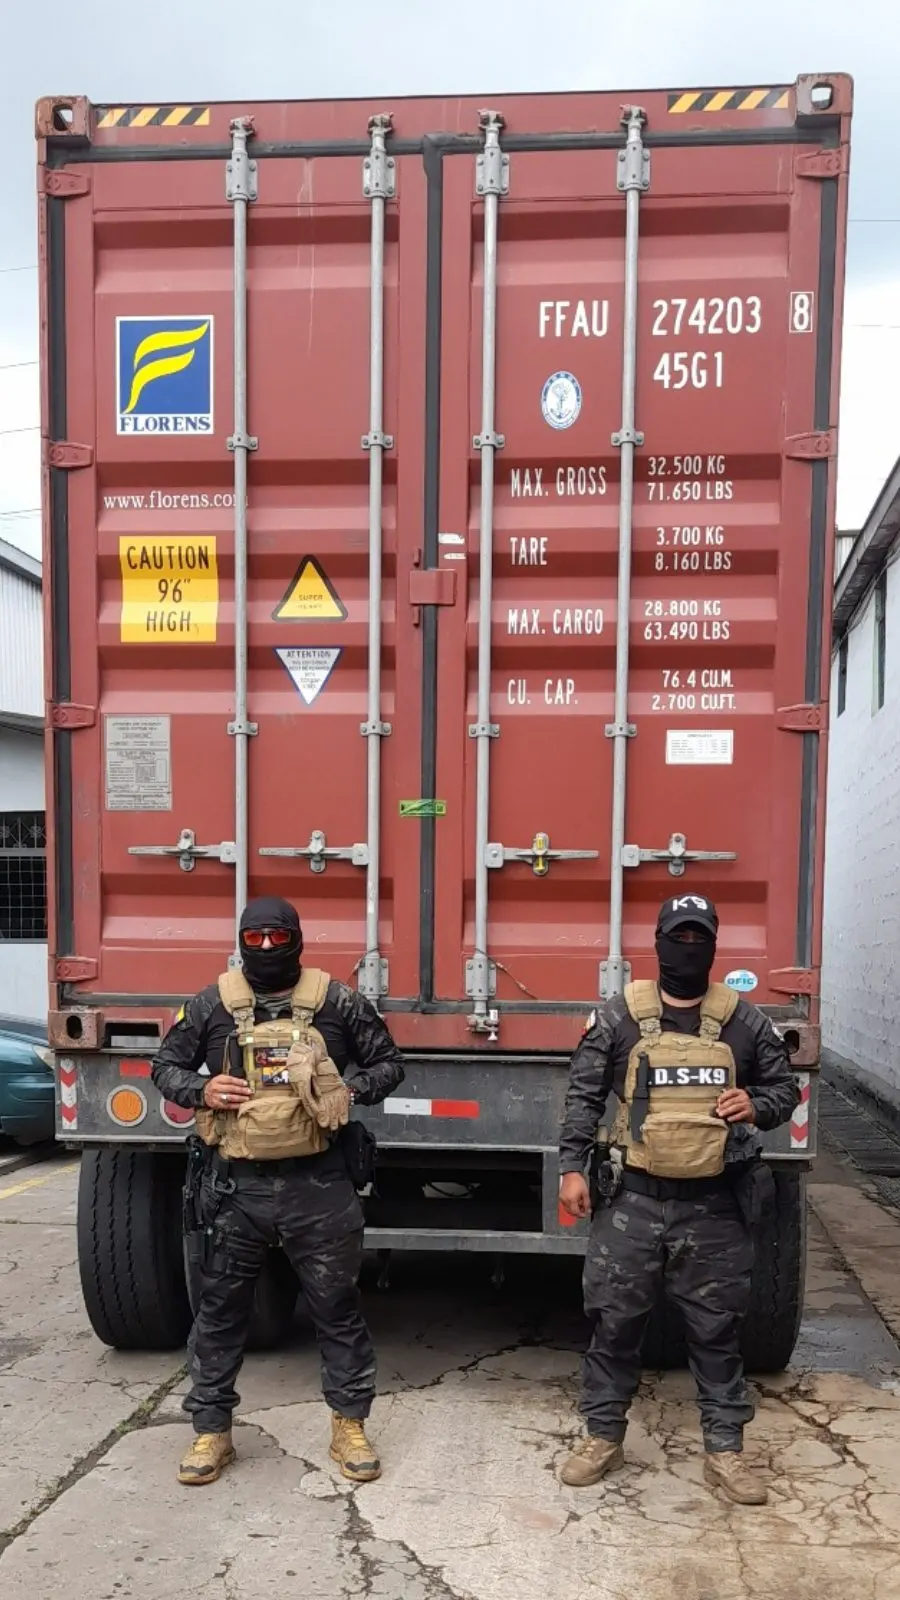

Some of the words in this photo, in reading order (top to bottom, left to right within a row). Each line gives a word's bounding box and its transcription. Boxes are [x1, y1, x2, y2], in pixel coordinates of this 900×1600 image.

[539, 300, 608, 337] FFAU
[652, 296, 762, 336] 274203
[794, 294, 809, 330] 8
[653, 352, 724, 388] 45G1
[120, 416, 211, 432] FLORENS
[648, 457, 702, 475] 32.500
[707, 455, 725, 474] KG
[511, 469, 548, 497] MAX.
[556, 466, 607, 495] GROSS
[648, 483, 701, 501] 71.650
[706, 481, 733, 500] LBS
[104, 491, 248, 509] www.florens.co
[656, 527, 701, 545] 3.700
[705, 526, 724, 544] KG
[126, 545, 209, 570] CAUTION
[510, 537, 548, 566] TARE
[655, 552, 699, 570] 8.160
[704, 551, 732, 570] LBS
[645, 601, 698, 616] 28.800
[703, 601, 721, 616] KG
[146, 611, 191, 632] HIGH
[507, 609, 546, 634] MAX.
[553, 608, 603, 633] CARGO
[644, 622, 698, 640] 63.490
[703, 621, 730, 639] LBS
[286, 650, 331, 658] ATTENTION
[662, 670, 696, 688] 76.4
[507, 681, 531, 704] CU.
[544, 679, 578, 704] CAP.
[652, 694, 695, 709] 2.700
[672, 896, 708, 911] K9
[677, 1068, 726, 1084] S-K9
